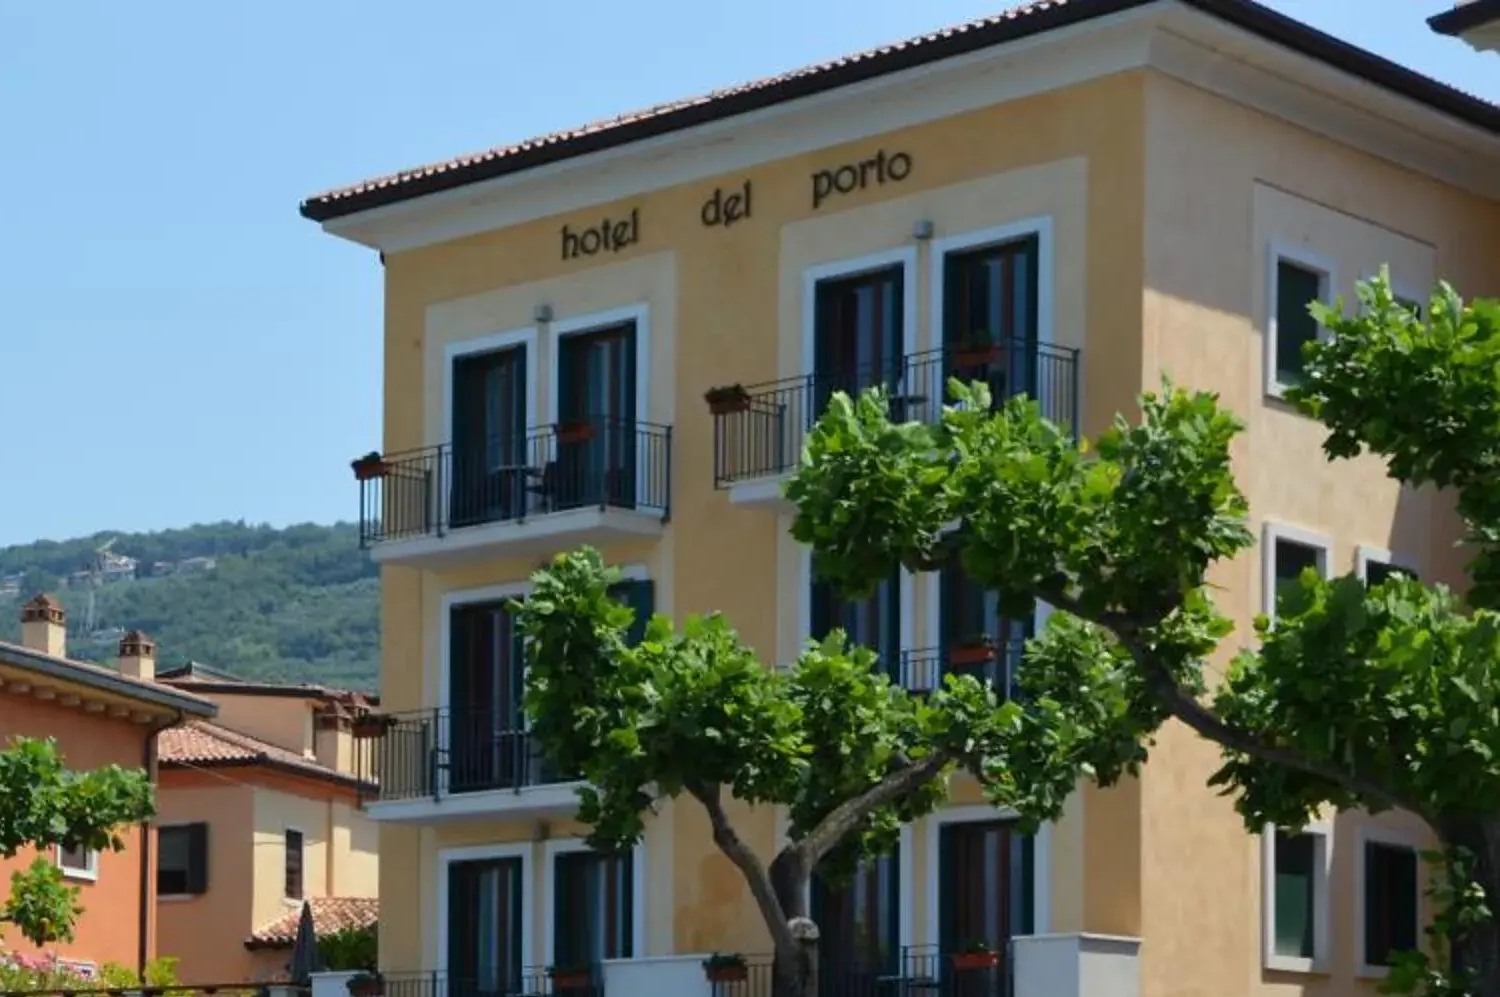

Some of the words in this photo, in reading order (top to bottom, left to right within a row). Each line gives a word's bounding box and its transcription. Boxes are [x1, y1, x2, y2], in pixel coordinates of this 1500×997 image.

[561, 208, 639, 260] hotel
[700, 178, 752, 229] del
[811, 149, 912, 209] porto
